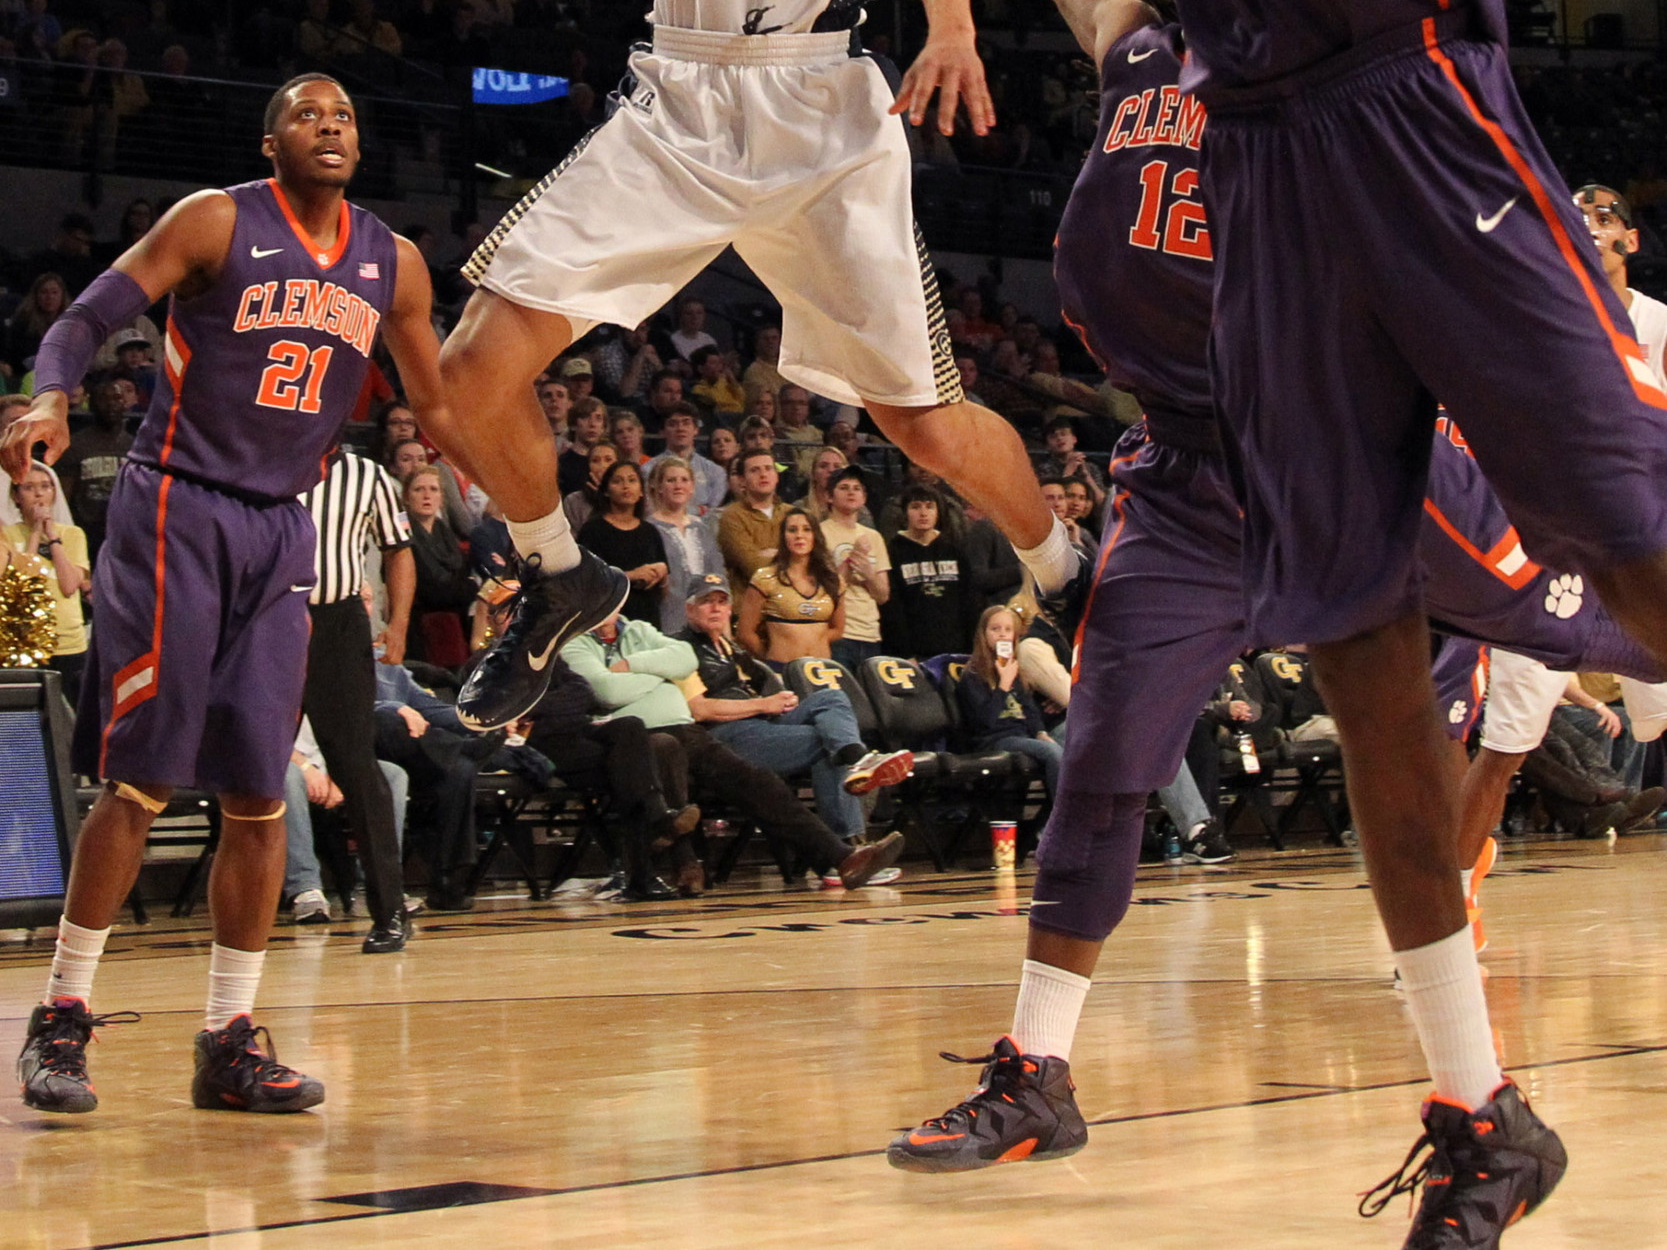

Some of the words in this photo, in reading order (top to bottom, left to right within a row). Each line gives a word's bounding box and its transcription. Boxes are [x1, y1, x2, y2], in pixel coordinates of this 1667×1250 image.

[1129, 160, 1214, 262] 12
[233, 279, 381, 358] CLEMSON
[255, 340, 334, 414] 21
